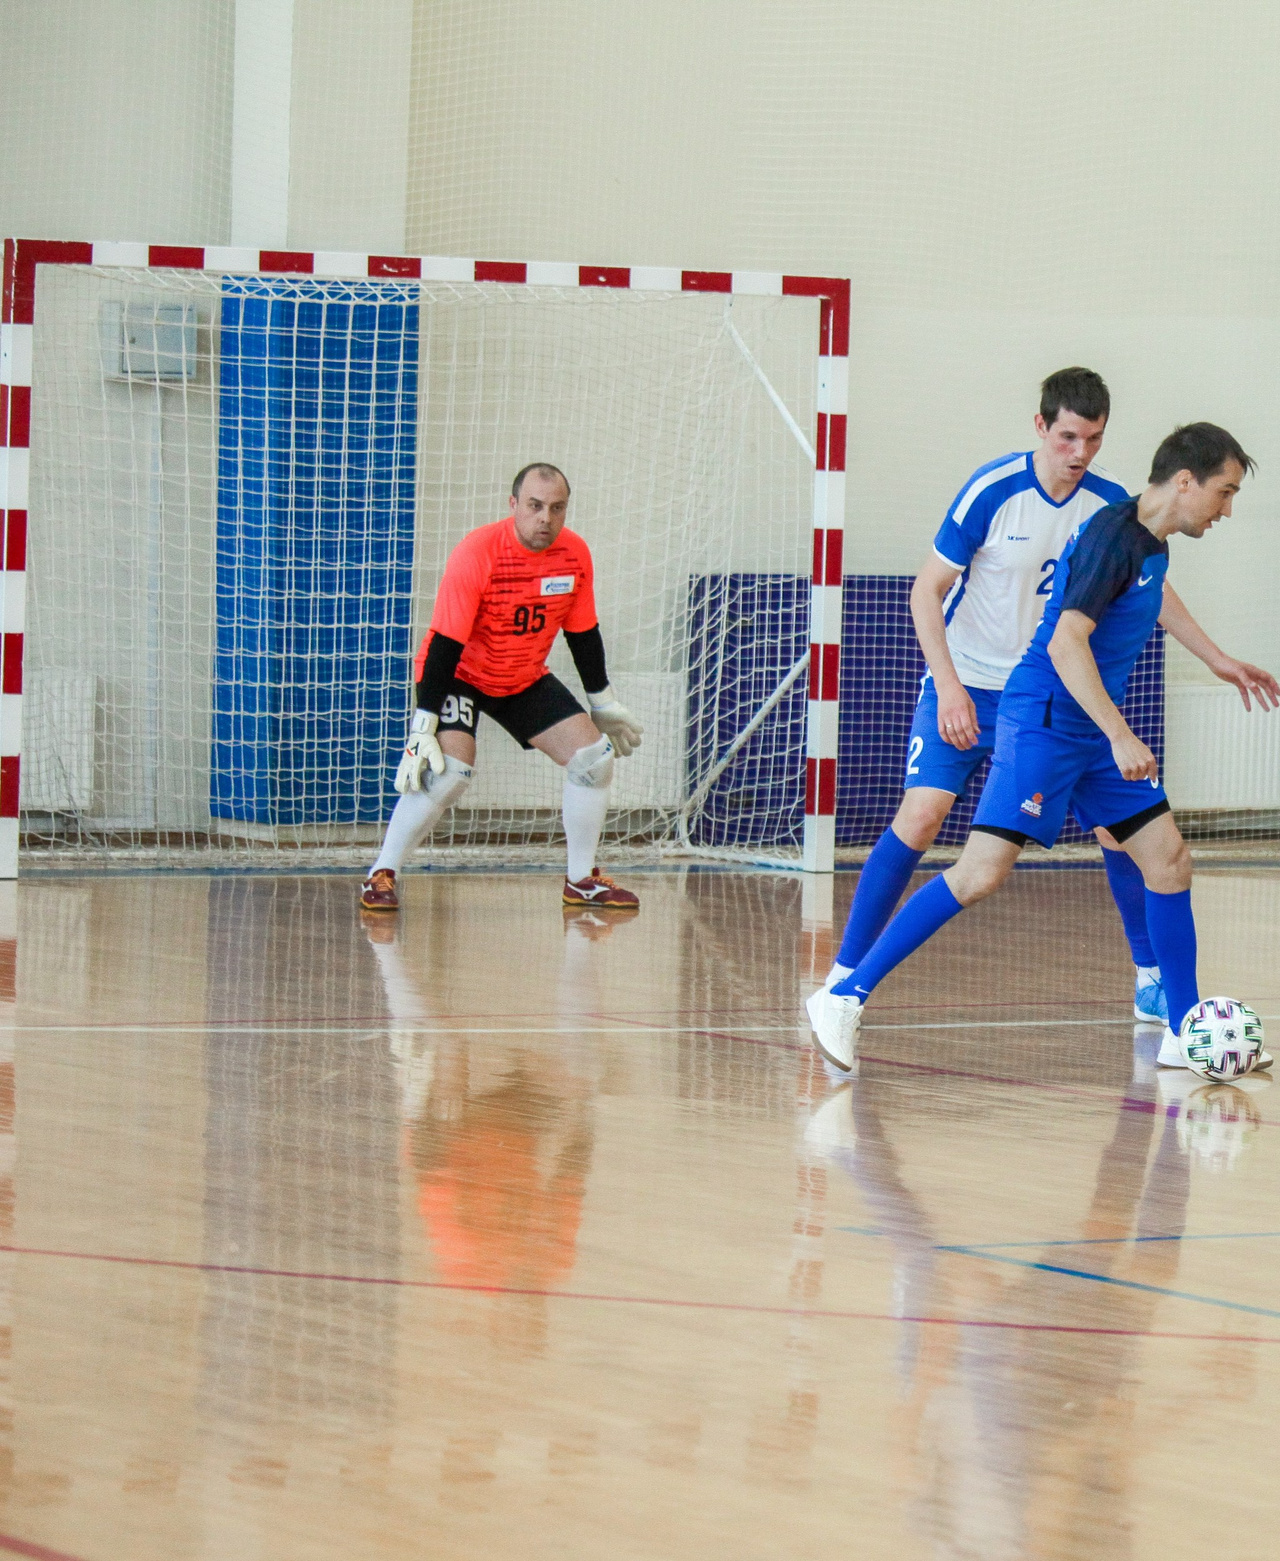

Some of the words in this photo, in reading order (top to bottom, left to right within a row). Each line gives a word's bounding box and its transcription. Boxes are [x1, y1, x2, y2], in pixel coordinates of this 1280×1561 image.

[1035, 558, 1059, 596] 2
[512, 604, 547, 636] 95
[440, 694, 474, 728] 95
[907, 736, 924, 776] 2
